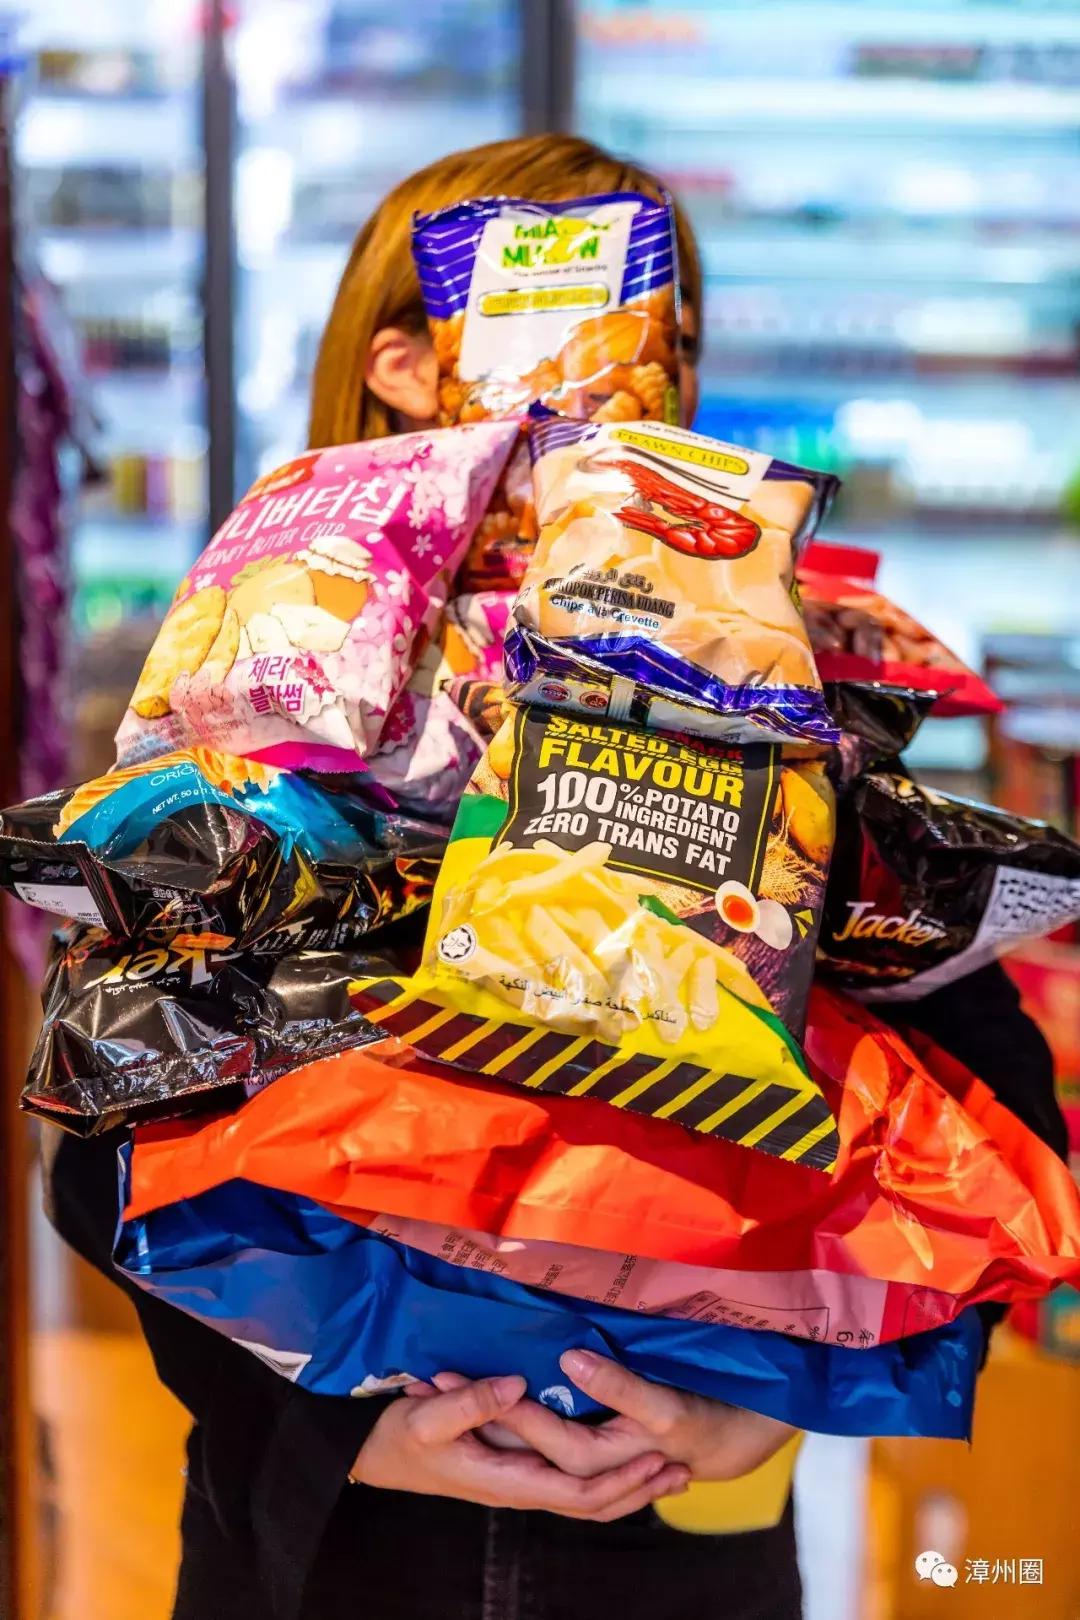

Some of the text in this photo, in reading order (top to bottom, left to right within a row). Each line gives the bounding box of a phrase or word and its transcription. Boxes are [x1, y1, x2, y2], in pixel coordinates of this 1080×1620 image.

[617, 430, 682, 457] PRAWN
[688, 447, 744, 471] CHIPS
[300, 521, 346, 541] CHIP
[543, 577, 676, 619] OPOK PERISA UDANG
[550, 593, 585, 613] Chips
[611, 607, 660, 629] Crevette
[248, 656, 288, 682] 체리
[547, 716, 669, 754] SALTED
[679, 749, 743, 774] EGG
[539, 737, 744, 808] FLAVOUR
[152, 800, 166, 814] NET
[181, 789, 192, 798] 50
[537, 771, 740, 833] 100% POTATO
[523, 812, 731, 876] ZERO TRANS FAT
[615, 801, 738, 852] INGREDIENT
[832, 901, 948, 947] Jacker
